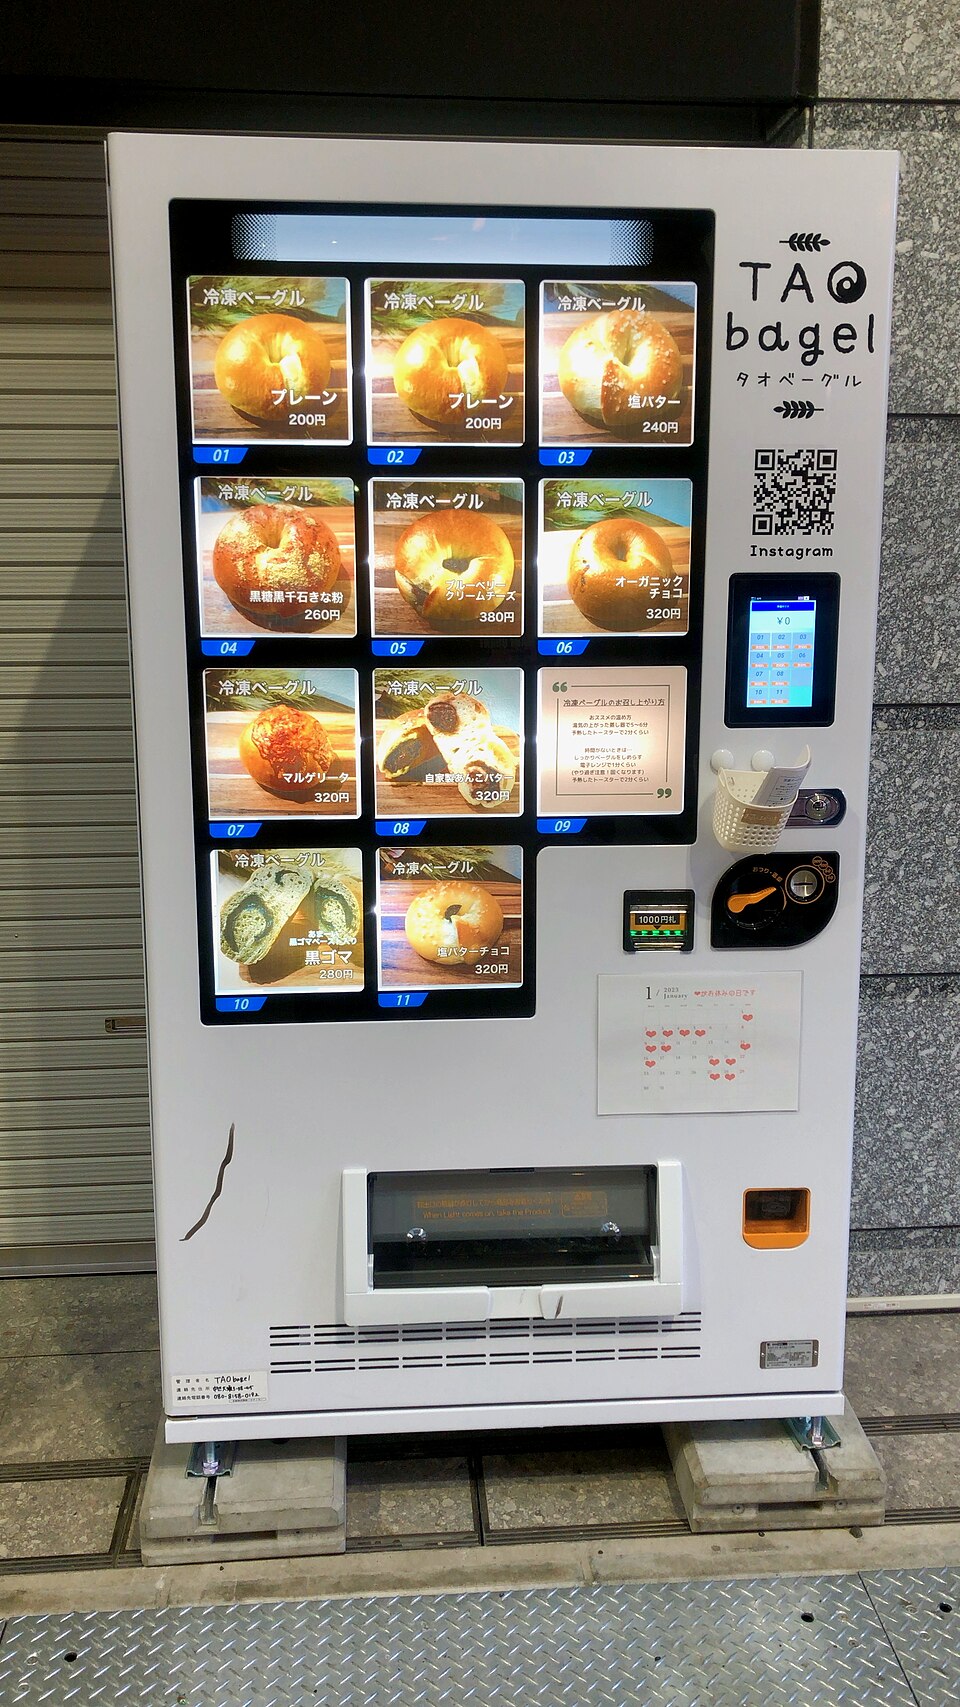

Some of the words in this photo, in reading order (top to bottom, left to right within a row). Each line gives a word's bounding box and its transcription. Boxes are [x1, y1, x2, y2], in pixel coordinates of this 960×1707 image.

[739, 261, 866, 303] TAO
[203, 289, 305, 306] 冷凍ベーグル
[384, 293, 484, 310] 冷凍ベーグル
[558, 296, 645, 311] 冷凍ベーグル
[726, 311, 875, 366] bagel
[737, 372, 861, 387] タオベーグル
[271, 390, 338, 405] プレーン
[448, 393, 513, 409] プレーン
[628, 396, 681, 408] 塩バター
[289, 414, 326, 426] 200円
[465, 417, 502, 429] 200円
[642, 422, 678, 433] 240円
[212, 450, 230, 461] 01
[387, 451, 403, 463] 02
[558, 452, 574, 464] 03
[218, 485, 313, 501] 冷凍ベーグル
[557, 491, 653, 507] 冷凍ベーグル
[386, 493, 484, 510] 冷凍ベーグル
[750, 545, 833, 559] Instagram
[446, 580, 505, 590] ブルーベリー
[615, 576, 683, 587] オーガニック
[249, 591, 343, 604] 黒糖黒千石きな粉
[446, 591, 516, 600] クリームチーズ
[649, 588, 682, 599] チョコ
[304, 609, 340, 621] 260円
[480, 612, 514, 622] 380円
[646, 608, 681, 619] 320円
[220, 642, 237, 654] 04
[390, 642, 406, 654] 05
[556, 641, 572, 654] 06
[219, 680, 316, 696] 冷凍ベーグル
[387, 680, 483, 695] 冷凍ベーグル
[282, 772, 349, 783] マルゲリータ
[425, 773, 513, 783] 自家製あんこバター
[314, 792, 349, 803] 320円
[476, 790, 510, 801] 320円
[227, 824, 244, 836] 07
[393, 822, 409, 835] 08
[555, 821, 571, 832] 09
[235, 853, 325, 868] 冷凍ベーグル
[392, 861, 474, 875] 冷凍ベーグル
[305, 950, 353, 965] 黒ゴマ
[437, 946, 510, 957] 塩バターチョコ
[320, 970, 353, 979] 280円
[475, 964, 508, 974] 320円
[646, 987, 651, 999] 1
[234, 998, 249, 1010] 10
[396, 994, 411, 1006] 11
